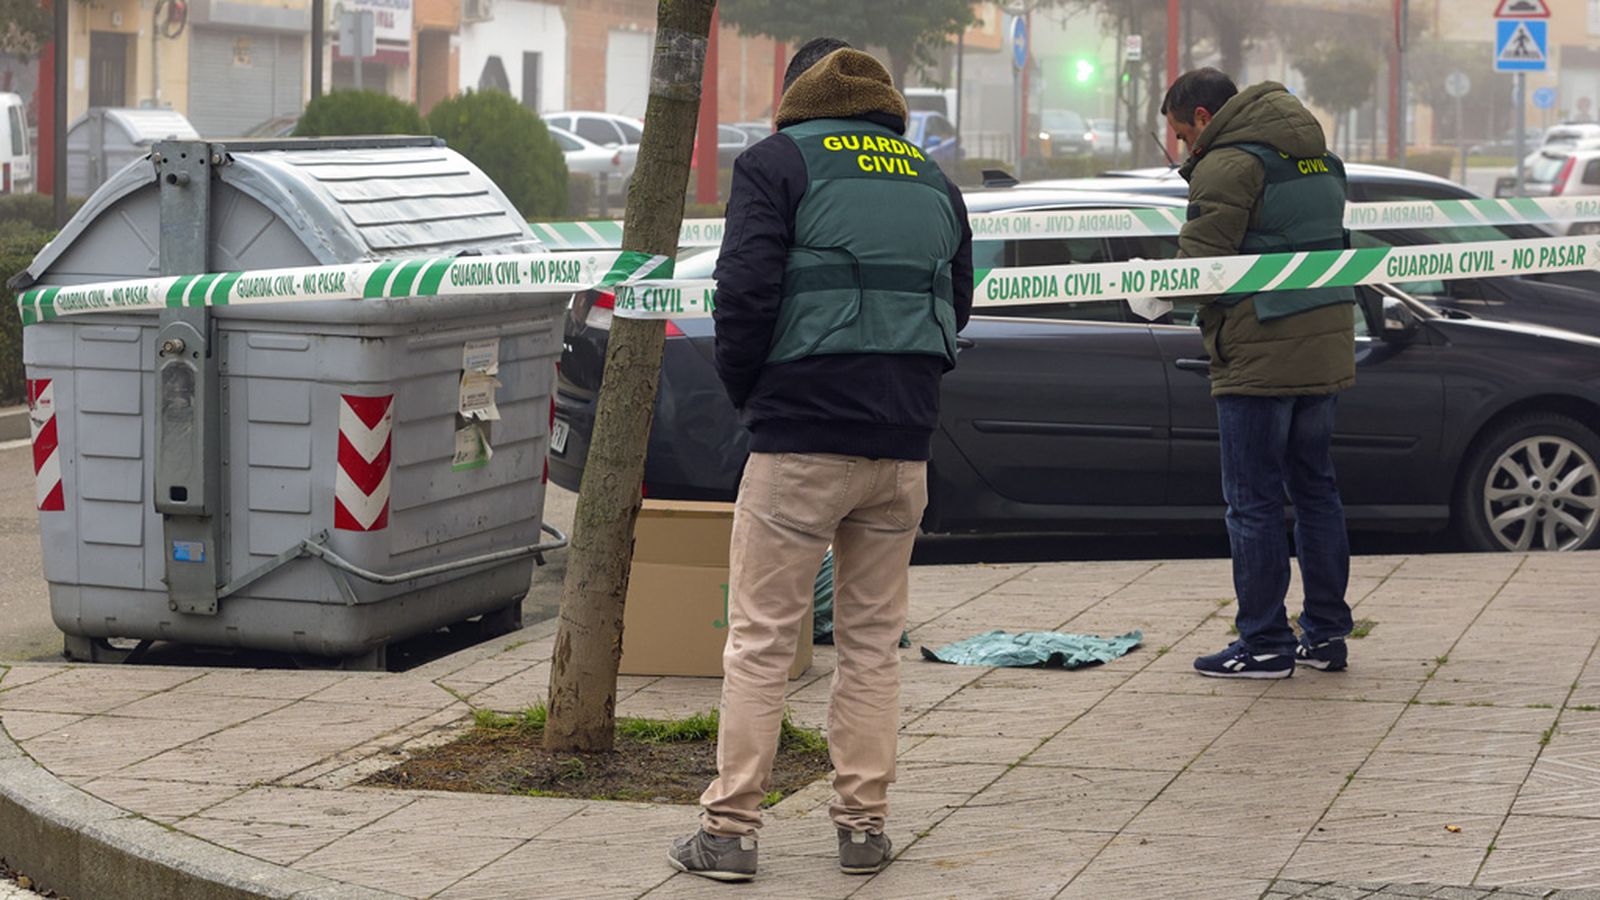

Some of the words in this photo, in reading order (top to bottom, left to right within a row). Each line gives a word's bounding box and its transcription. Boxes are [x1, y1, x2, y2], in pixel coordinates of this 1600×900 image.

[823, 135, 926, 162] GUARDIA
[857, 154, 918, 176] CIVIL
[1297, 159, 1328, 174] CIVIL
[450, 262, 493, 287] GUARDIA
[496, 262, 521, 286] CIVIL
[530, 260, 547, 283] NO
[548, 259, 581, 284] PASAR
[1387, 252, 1453, 278] GUARDIA
[1459, 250, 1495, 273] CIVIL
[1512, 247, 1534, 269] NO
[1539, 244, 1586, 268] PASAR
[236, 276, 274, 298] GUARDIA
[274, 274, 296, 295] CIVIL
[303, 273, 317, 293] NO
[317, 271, 346, 293] PASAR
[987, 273, 1058, 300] GUARDIA
[1064, 272, 1103, 297] CIVIL
[1121, 269, 1145, 293] NO
[1150, 267, 1200, 291] PASAR
[642, 288, 684, 313] CIVIL
[704, 288, 718, 312] N
